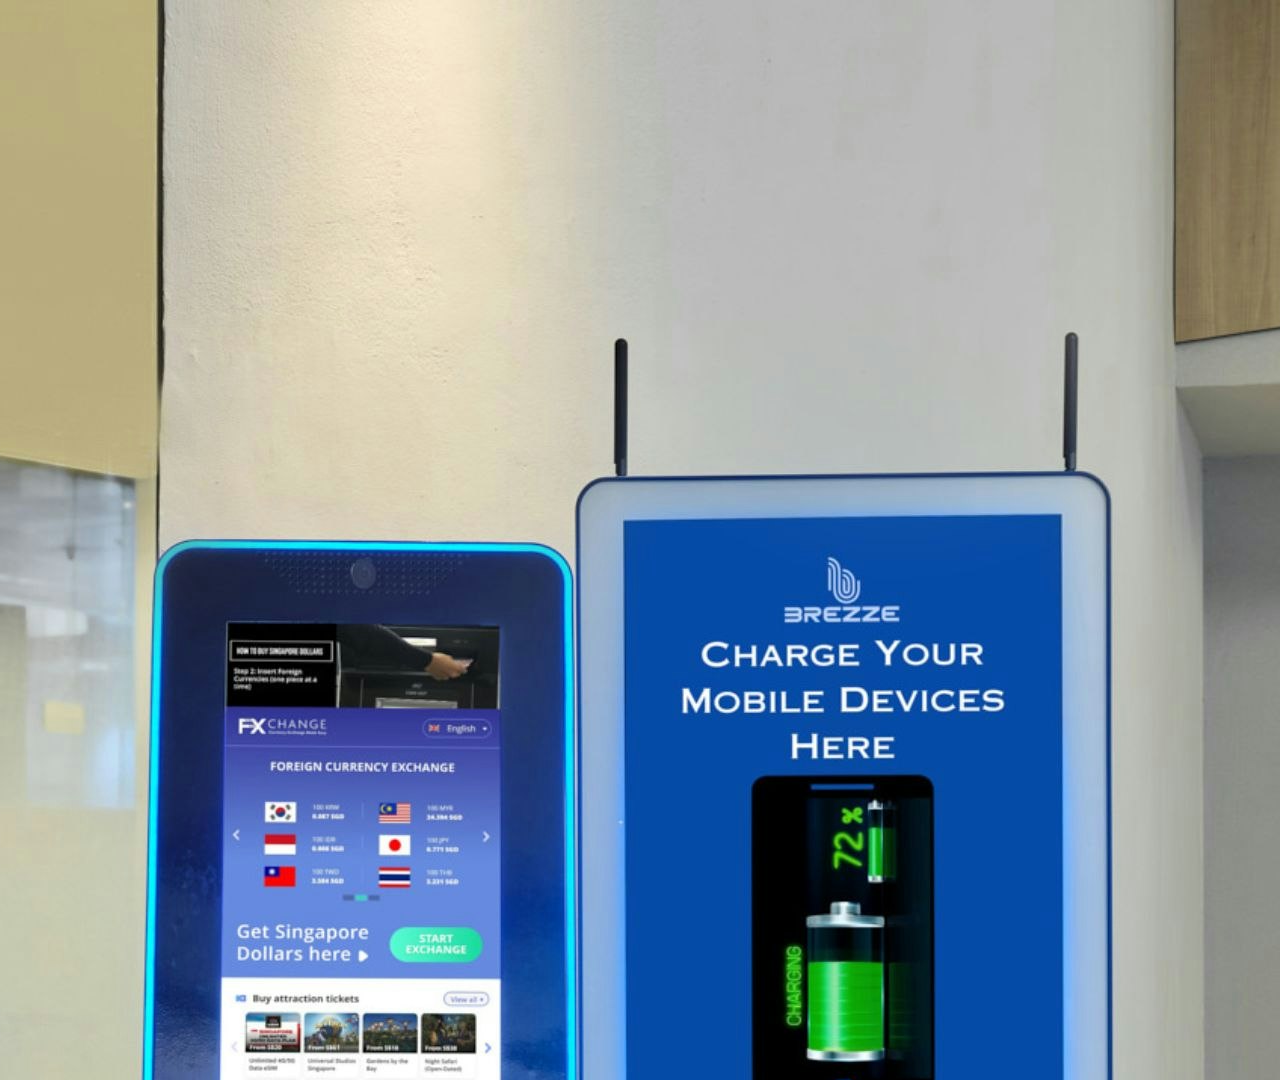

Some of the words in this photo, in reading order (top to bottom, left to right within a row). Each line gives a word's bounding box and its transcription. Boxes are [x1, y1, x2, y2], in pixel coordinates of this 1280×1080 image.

[784, 605, 900, 622] BREZZE
[447, 724, 476, 735] English
[270, 761, 322, 771] FOREIGN
[325, 762, 388, 772] CURRENCY
[392, 762, 456, 773] EXCHANGE
[237, 924, 270, 939] Get
[275, 924, 369, 944] Singapore
[419, 934, 453, 943] START
[237, 945, 303, 961] Dollars
[309, 946, 351, 961] here
[406, 945, 467, 954] EXCHANGE
[785, 945, 803, 1027] CHARGING
[253, 994, 272, 1004] Buy
[274, 994, 323, 1003] attraction
[326, 994, 360, 1003] tickets
